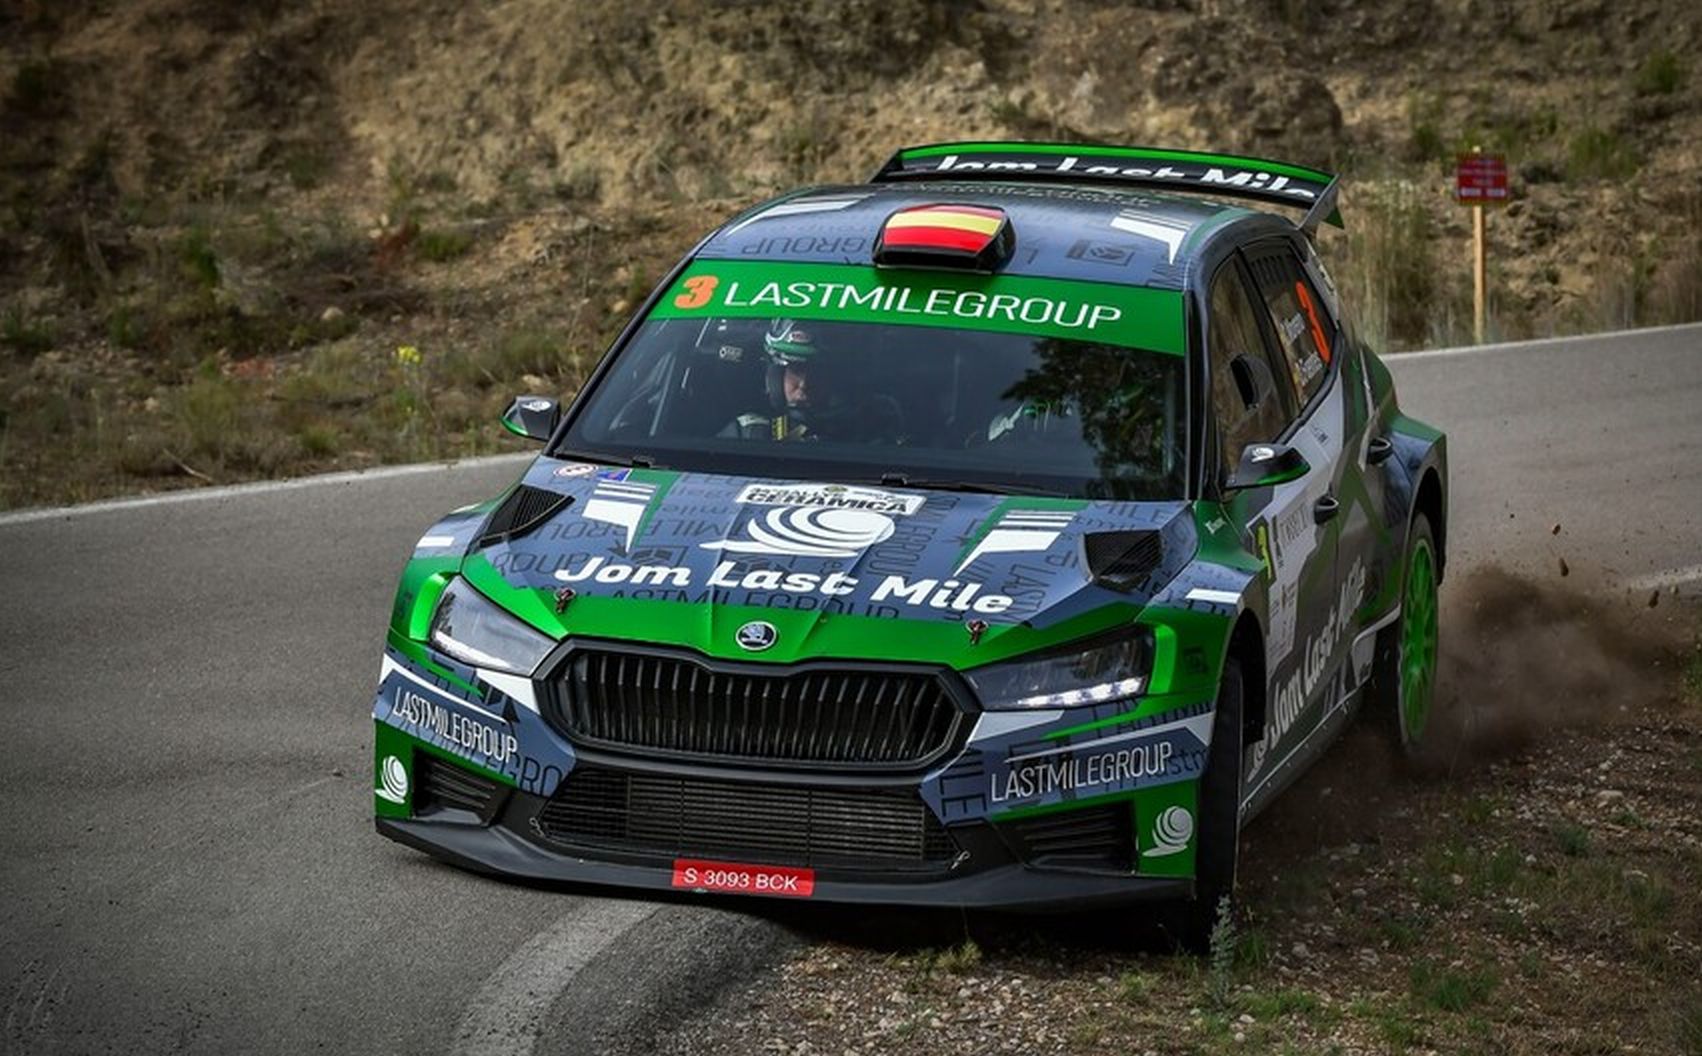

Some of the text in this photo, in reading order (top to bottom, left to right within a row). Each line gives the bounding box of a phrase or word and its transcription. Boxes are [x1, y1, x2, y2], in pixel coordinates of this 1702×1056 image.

[674, 274, 1122, 330] 3 LASTMILEGROUP
[554, 556, 1013, 614] Jom Last Mile
[392, 686, 518, 763] LASTMILEGROUP
[991, 742, 1172, 802] LASTMILEGROUP
[683, 867, 799, 891] S 3093 BCK
